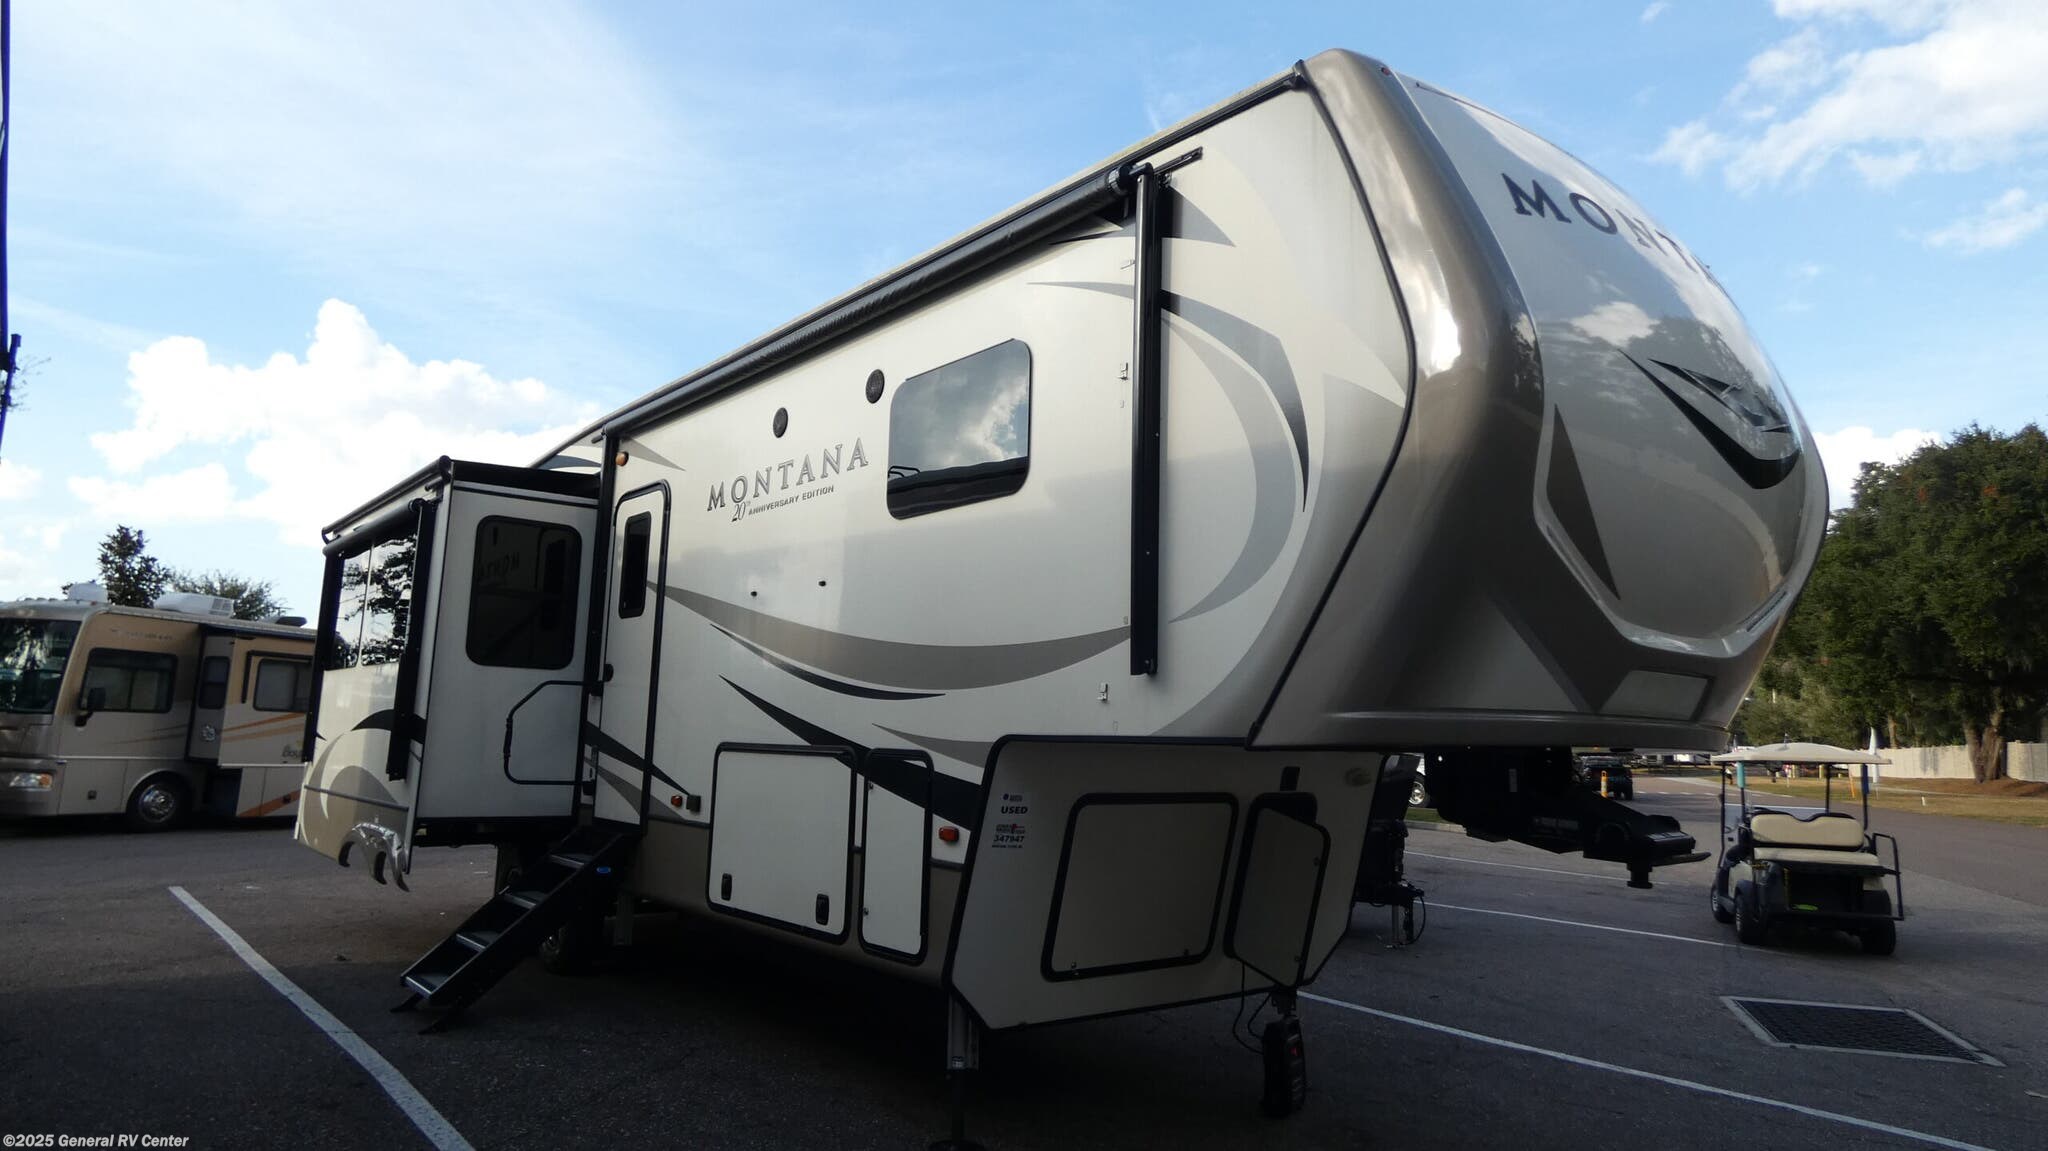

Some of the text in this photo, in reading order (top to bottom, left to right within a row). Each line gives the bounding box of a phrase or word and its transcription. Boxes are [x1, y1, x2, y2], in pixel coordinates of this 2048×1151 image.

[707, 437, 869, 511] MONTANA
[748, 495, 799, 515] ANNIVERSARY
[802, 485, 834, 501] EDITION
[1001, 806, 1028, 814] USED
